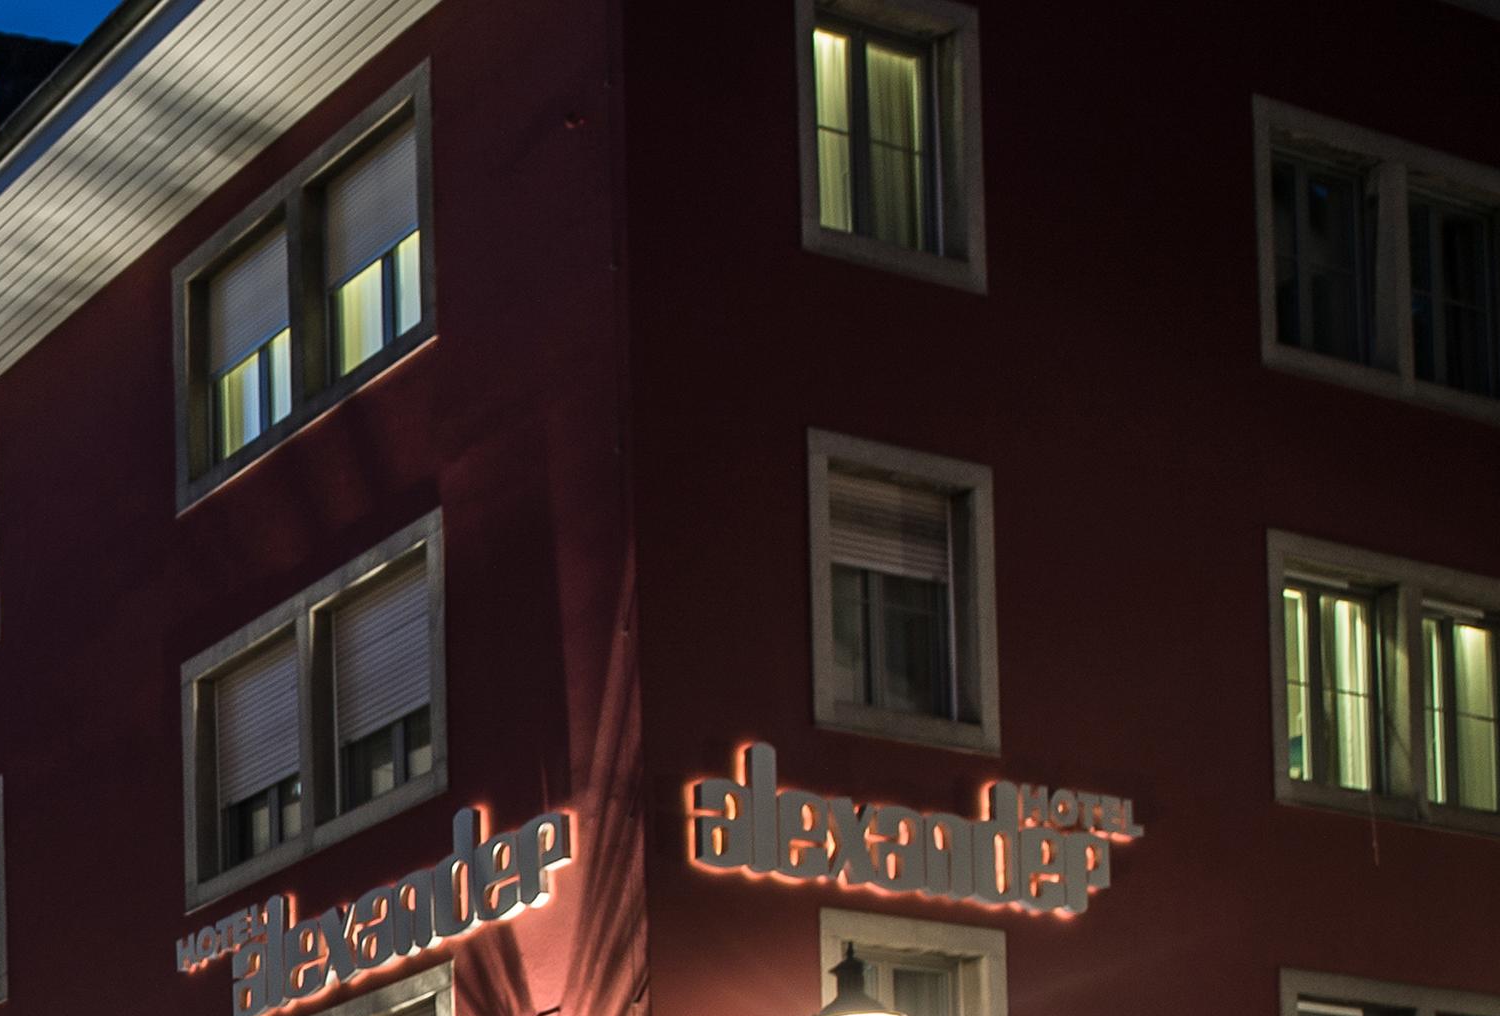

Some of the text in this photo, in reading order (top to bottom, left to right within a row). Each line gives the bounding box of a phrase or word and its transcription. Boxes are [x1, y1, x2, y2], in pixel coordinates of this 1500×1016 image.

[694, 741, 1111, 914] alexander
[1022, 782, 1145, 838] HOTEL
[176, 898, 269, 973] HOTEL
